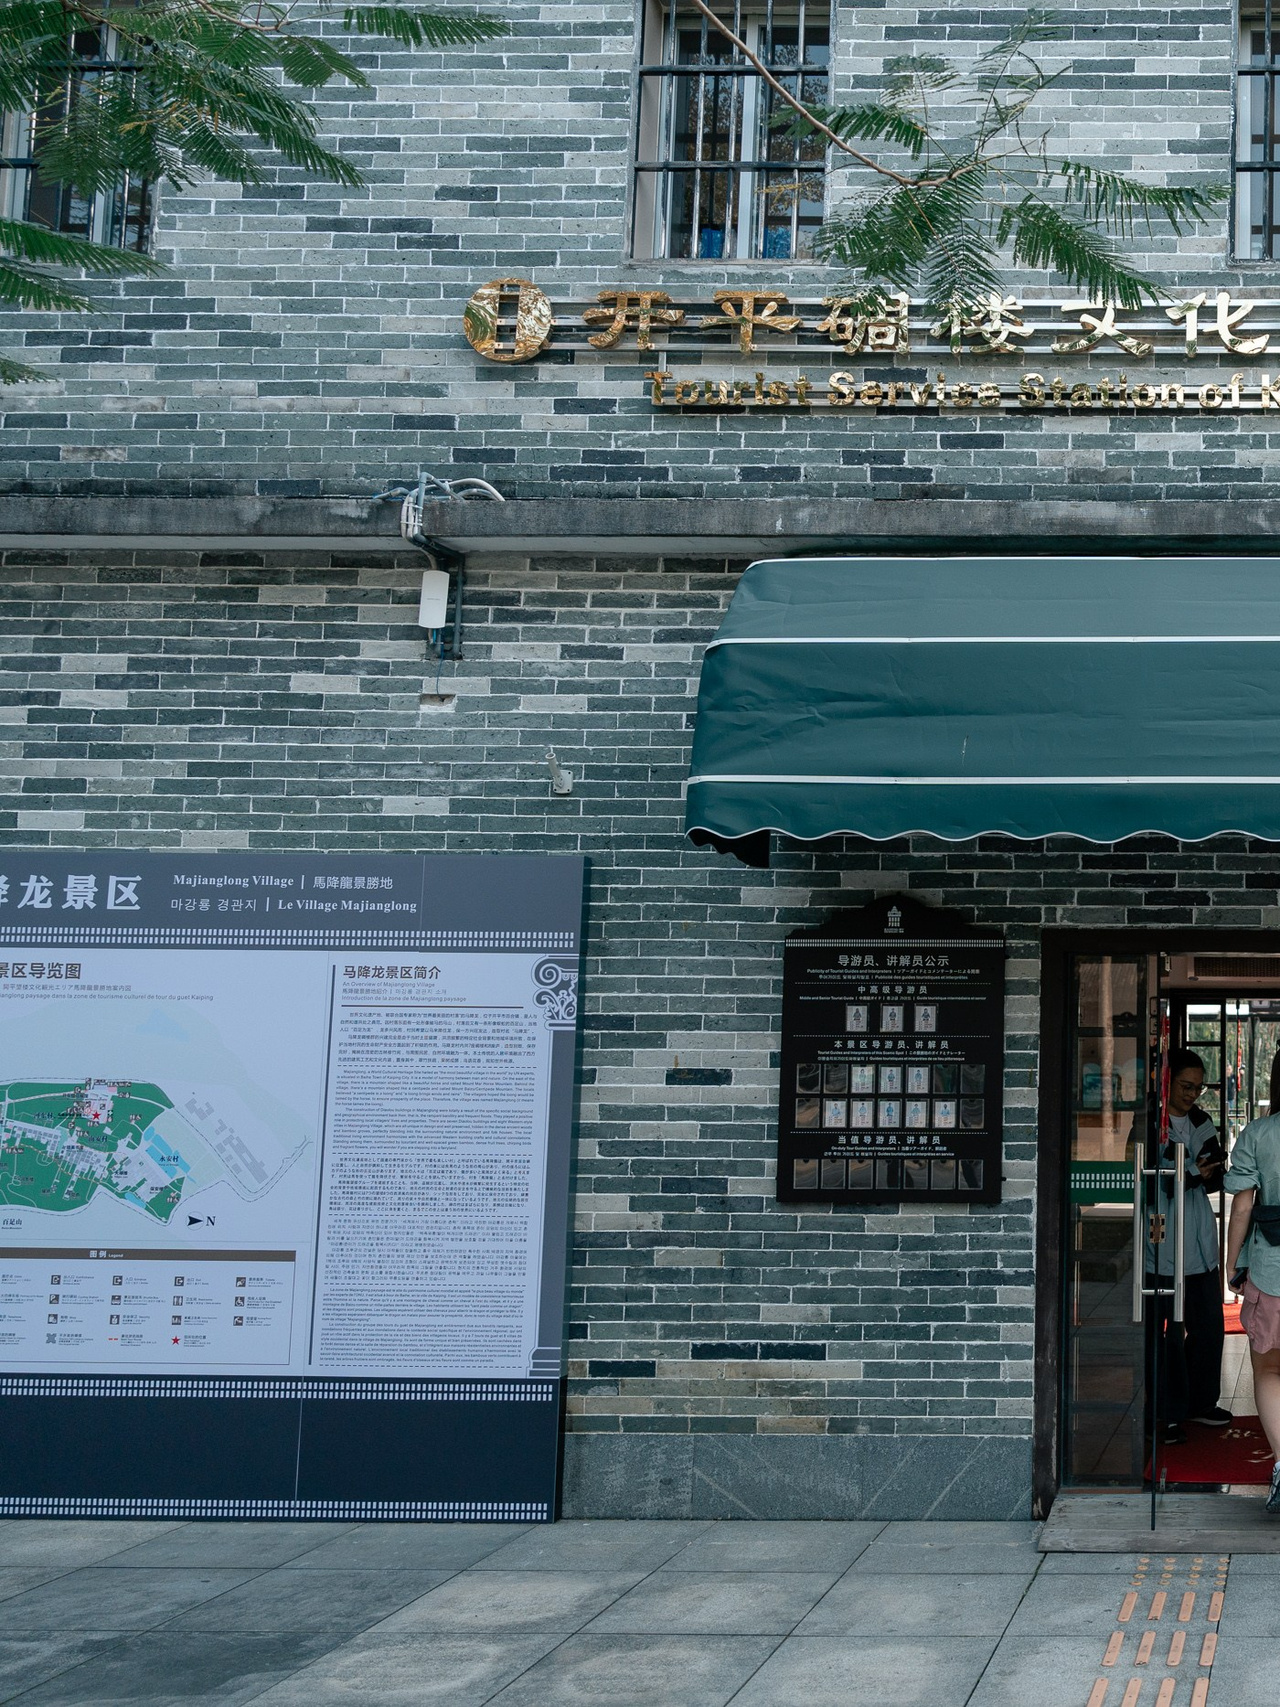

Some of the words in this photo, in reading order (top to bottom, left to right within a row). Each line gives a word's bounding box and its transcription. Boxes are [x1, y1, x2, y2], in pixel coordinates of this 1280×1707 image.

[644, 371, 814, 406] Tourist
[828, 371, 1000, 406] Service
[1020, 372, 1185, 407] Station
[1200, 372, 1246, 407] of
[173, 874, 249, 887] Majianglong
[252, 875, 294, 887] Village
[313, 876, 393, 889] 馬降龍景勝地
[0, 873, 142, 910] 龙景区
[171, 898, 210, 911] 마강룡
[218, 899, 257, 912] 경관지
[278, 899, 293, 910] Le
[296, 900, 337, 912] Village
[340, 900, 417, 912] Majianglong
[838, 955, 950, 967] 导游员、讲解员公示
[343, 965, 441, 979] 马降龙景区简介
[858, 985, 927, 994] 中高级导游员
[206, 1216, 216, 1226] N
